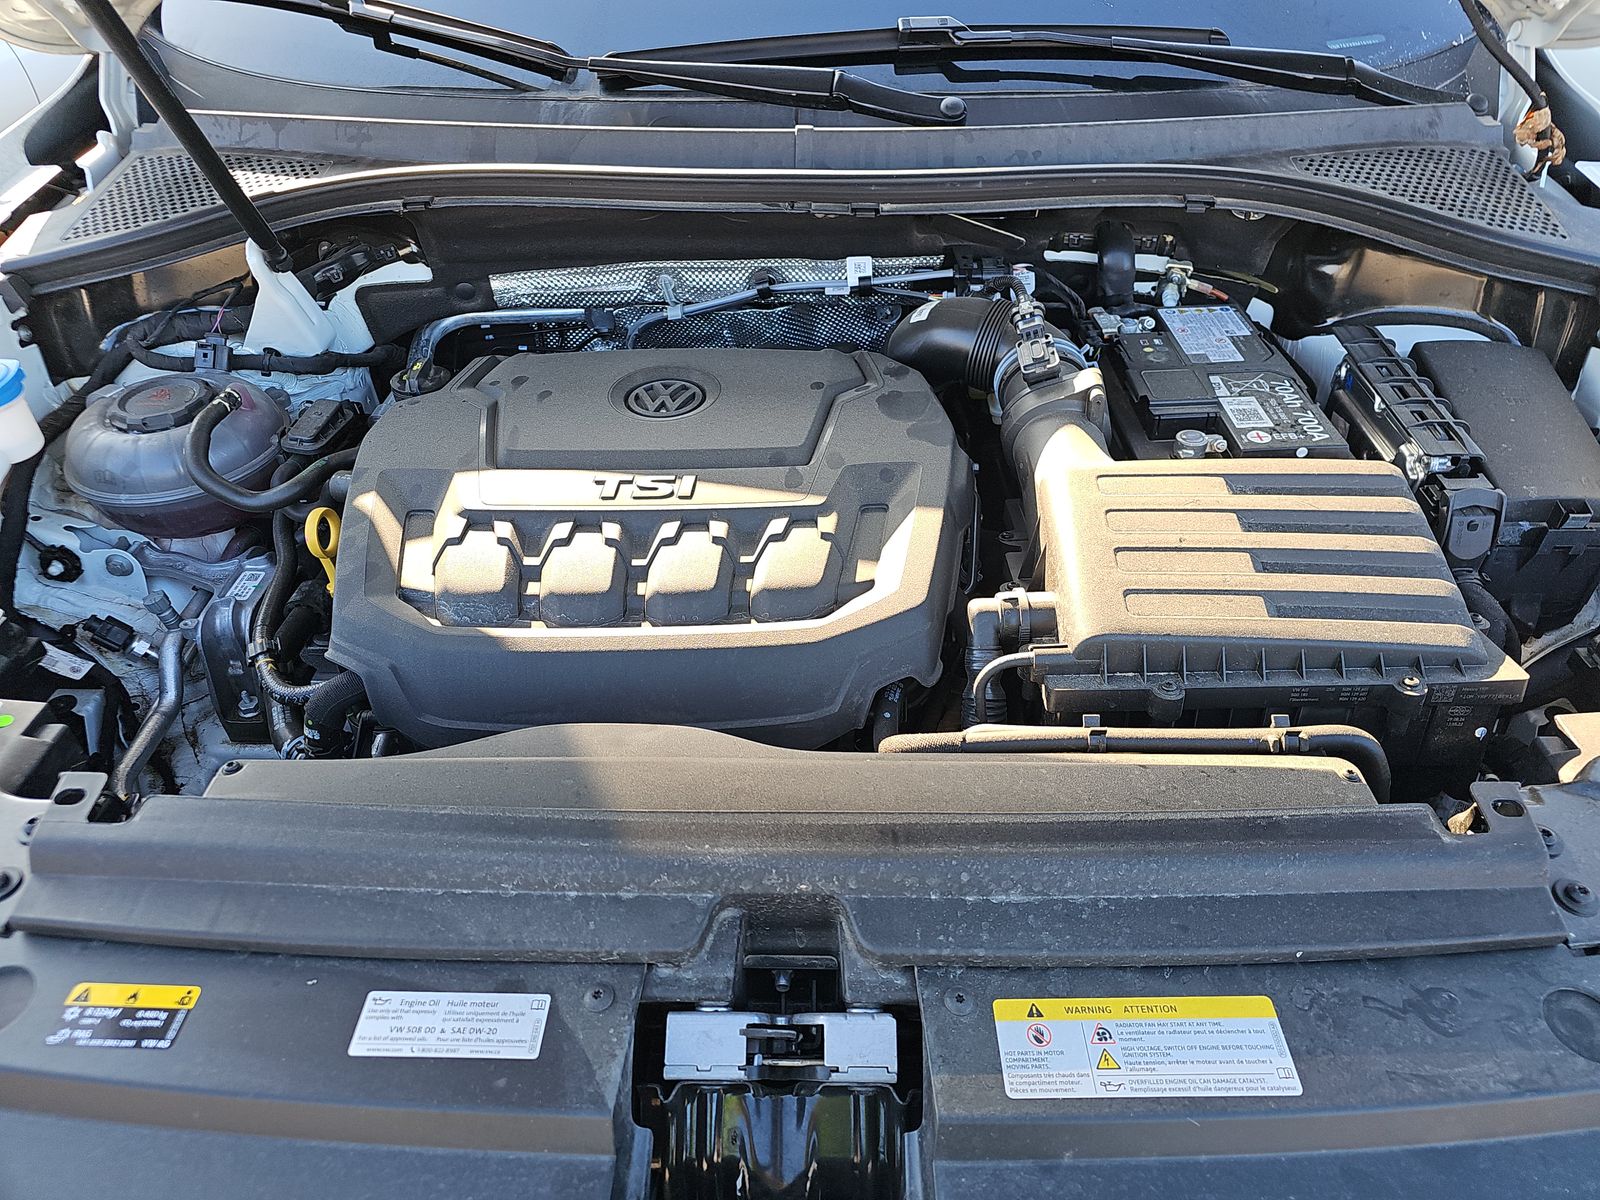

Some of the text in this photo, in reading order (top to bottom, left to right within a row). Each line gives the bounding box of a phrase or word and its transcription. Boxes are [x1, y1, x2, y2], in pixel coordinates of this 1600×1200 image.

[1270, 379, 1304, 408] 70Ah
[1292, 410, 1330, 442] 700A
[593, 474, 698, 500] TSI
[400, 999, 428, 1008] Engine
[428, 999, 441, 1007] Oil
[1064, 1004, 1178, 1015] WARNING ATTENTION
[469, 1027, 498, 1035] 0W-20
